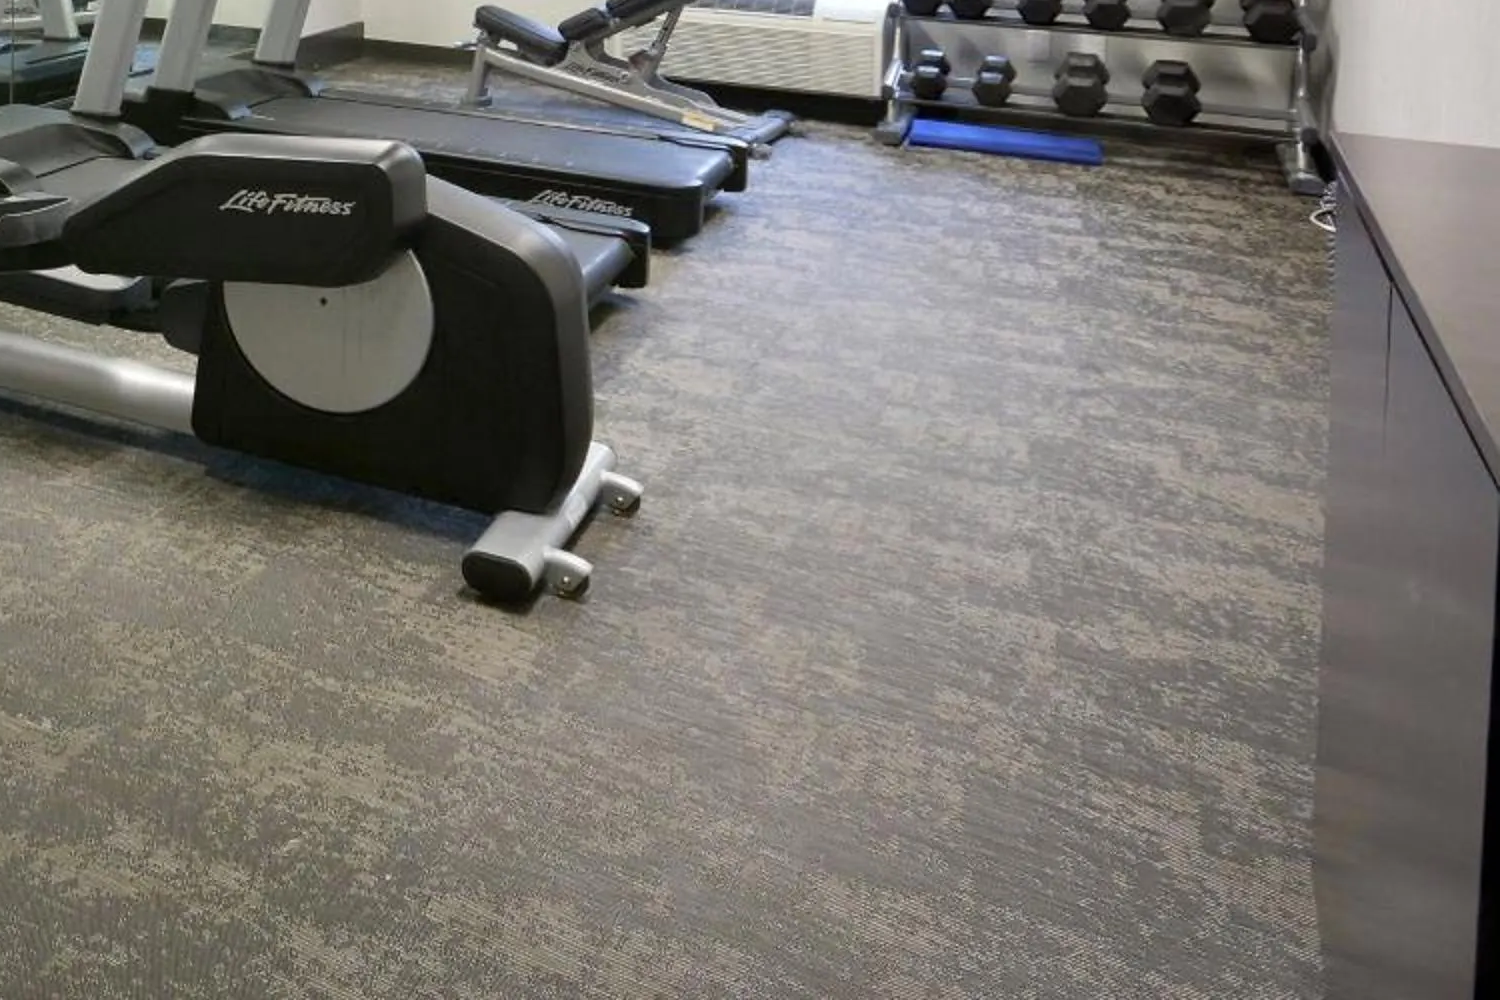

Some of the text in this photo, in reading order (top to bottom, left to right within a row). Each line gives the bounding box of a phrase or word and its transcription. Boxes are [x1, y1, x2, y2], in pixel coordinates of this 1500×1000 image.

[219, 189, 357, 216] Life Fitness
[564, 195, 634, 217] Fitness
